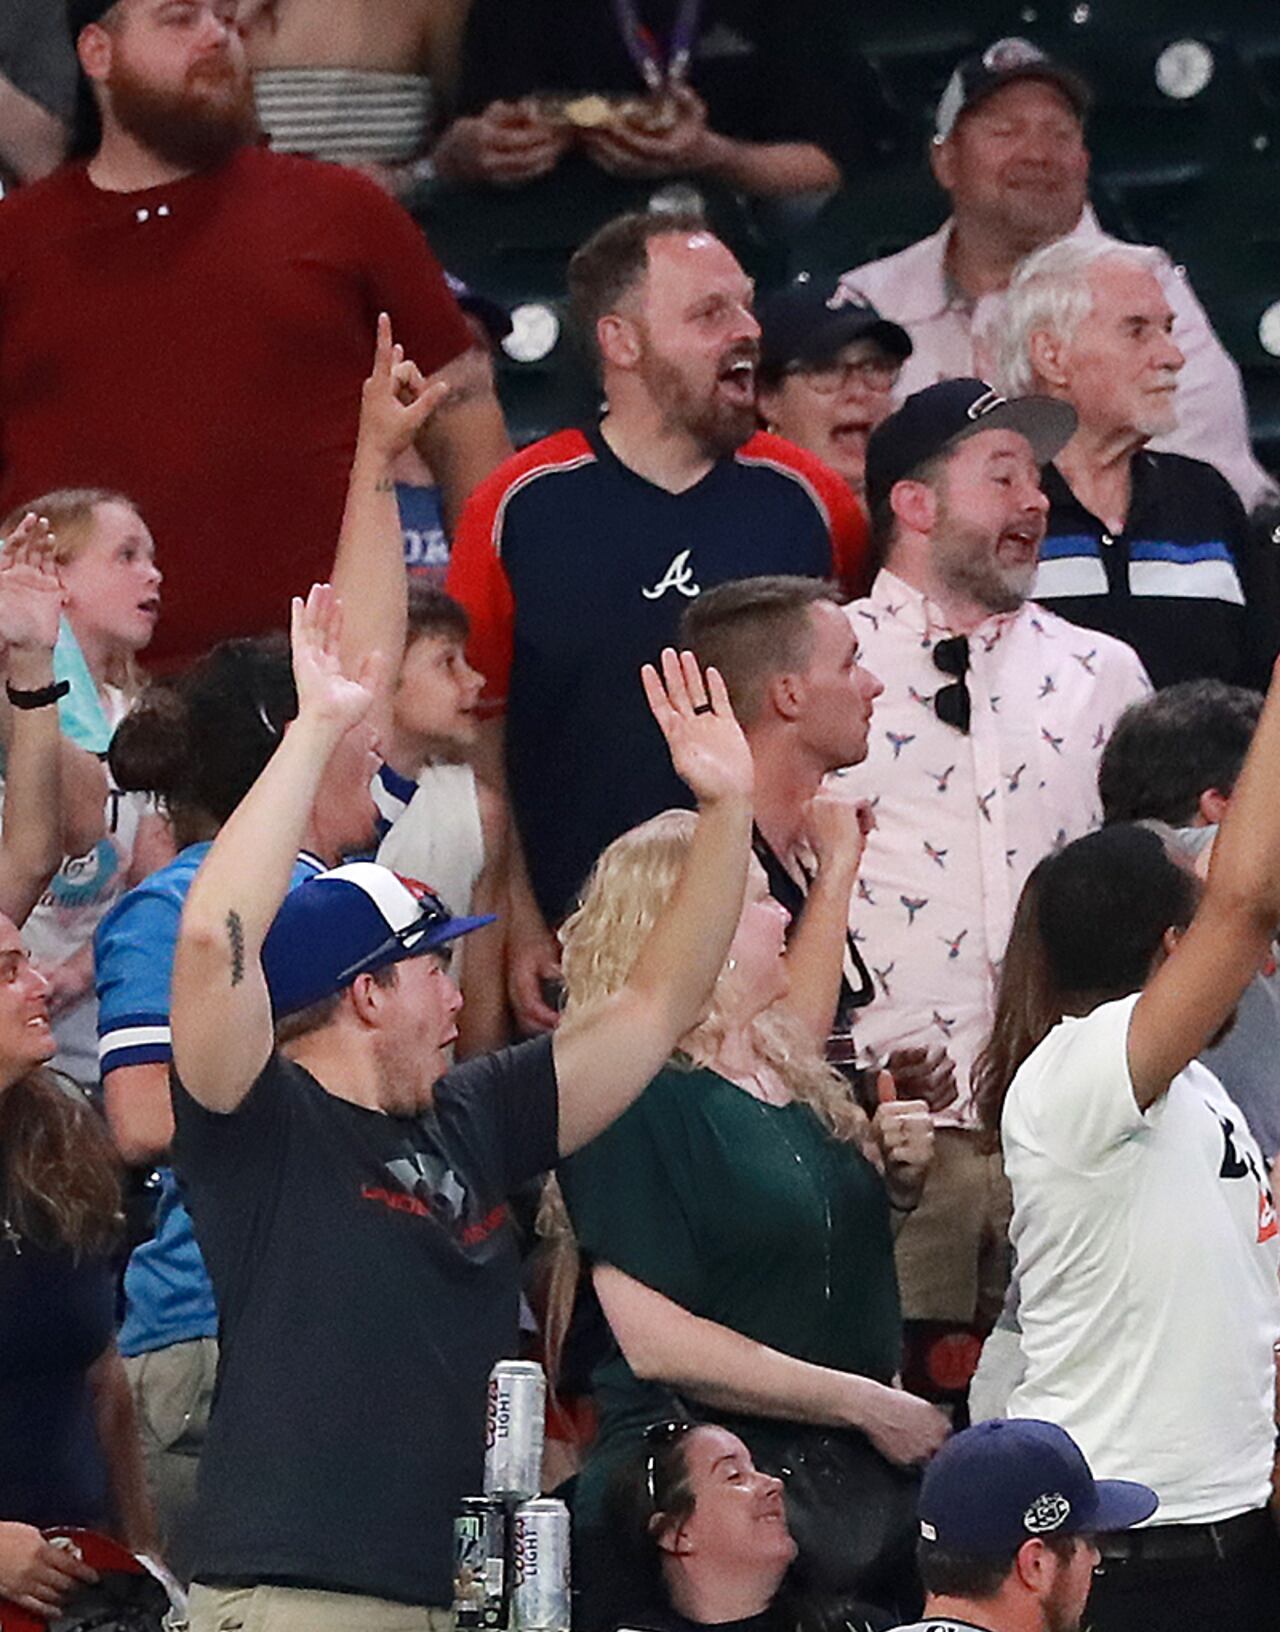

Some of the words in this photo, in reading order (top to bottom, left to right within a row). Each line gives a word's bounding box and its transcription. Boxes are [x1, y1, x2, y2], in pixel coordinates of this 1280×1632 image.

[642, 549, 700, 600] A
[497, 1392, 510, 1438] LIGHT
[524, 1529, 538, 1576] LIGHT
